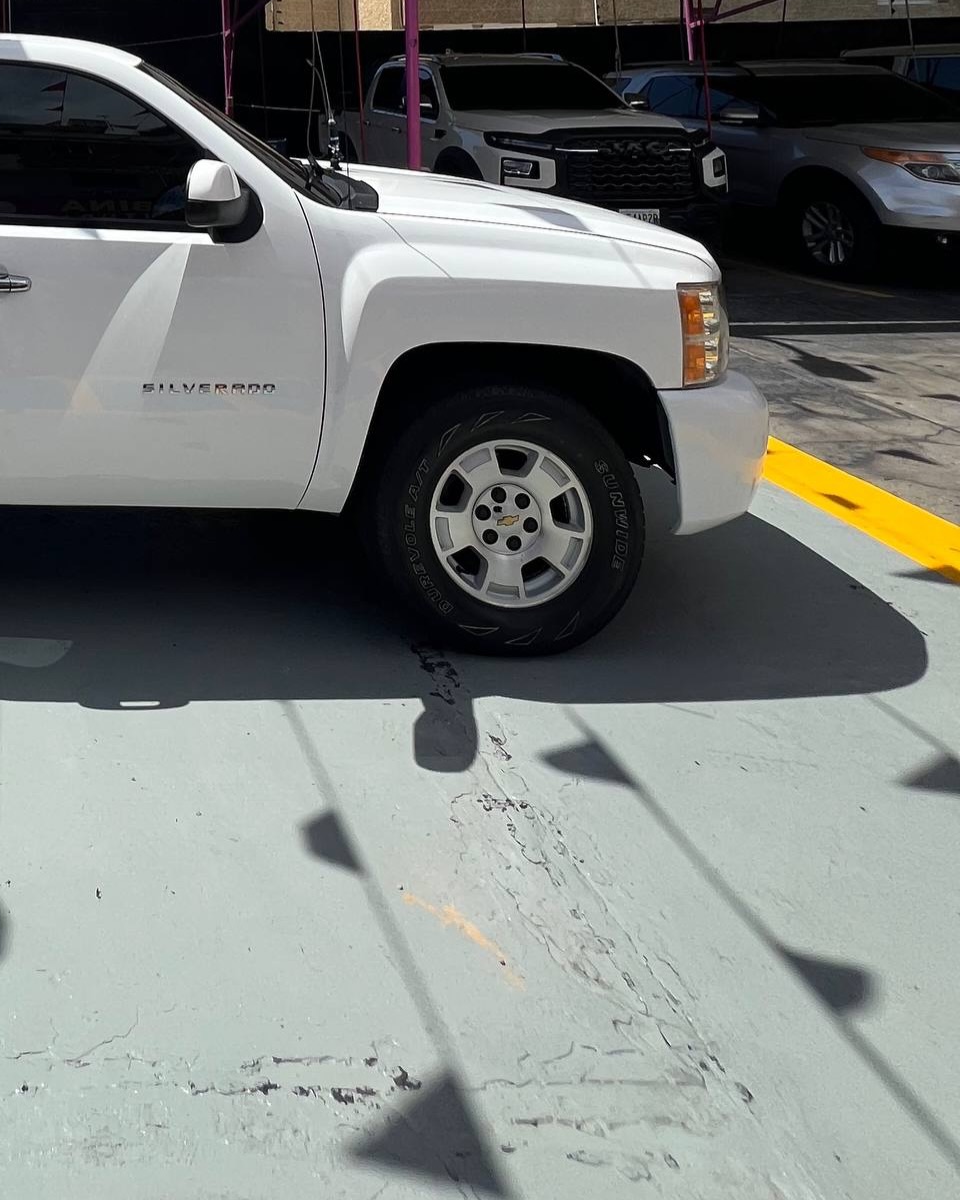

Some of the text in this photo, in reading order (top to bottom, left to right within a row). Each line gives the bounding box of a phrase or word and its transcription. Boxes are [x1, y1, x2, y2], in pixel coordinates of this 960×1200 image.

[142, 383, 277, 395] SILVERADO
[401, 504, 455, 617] DUREVOLE
[592, 458, 631, 571] SUNWIDE
